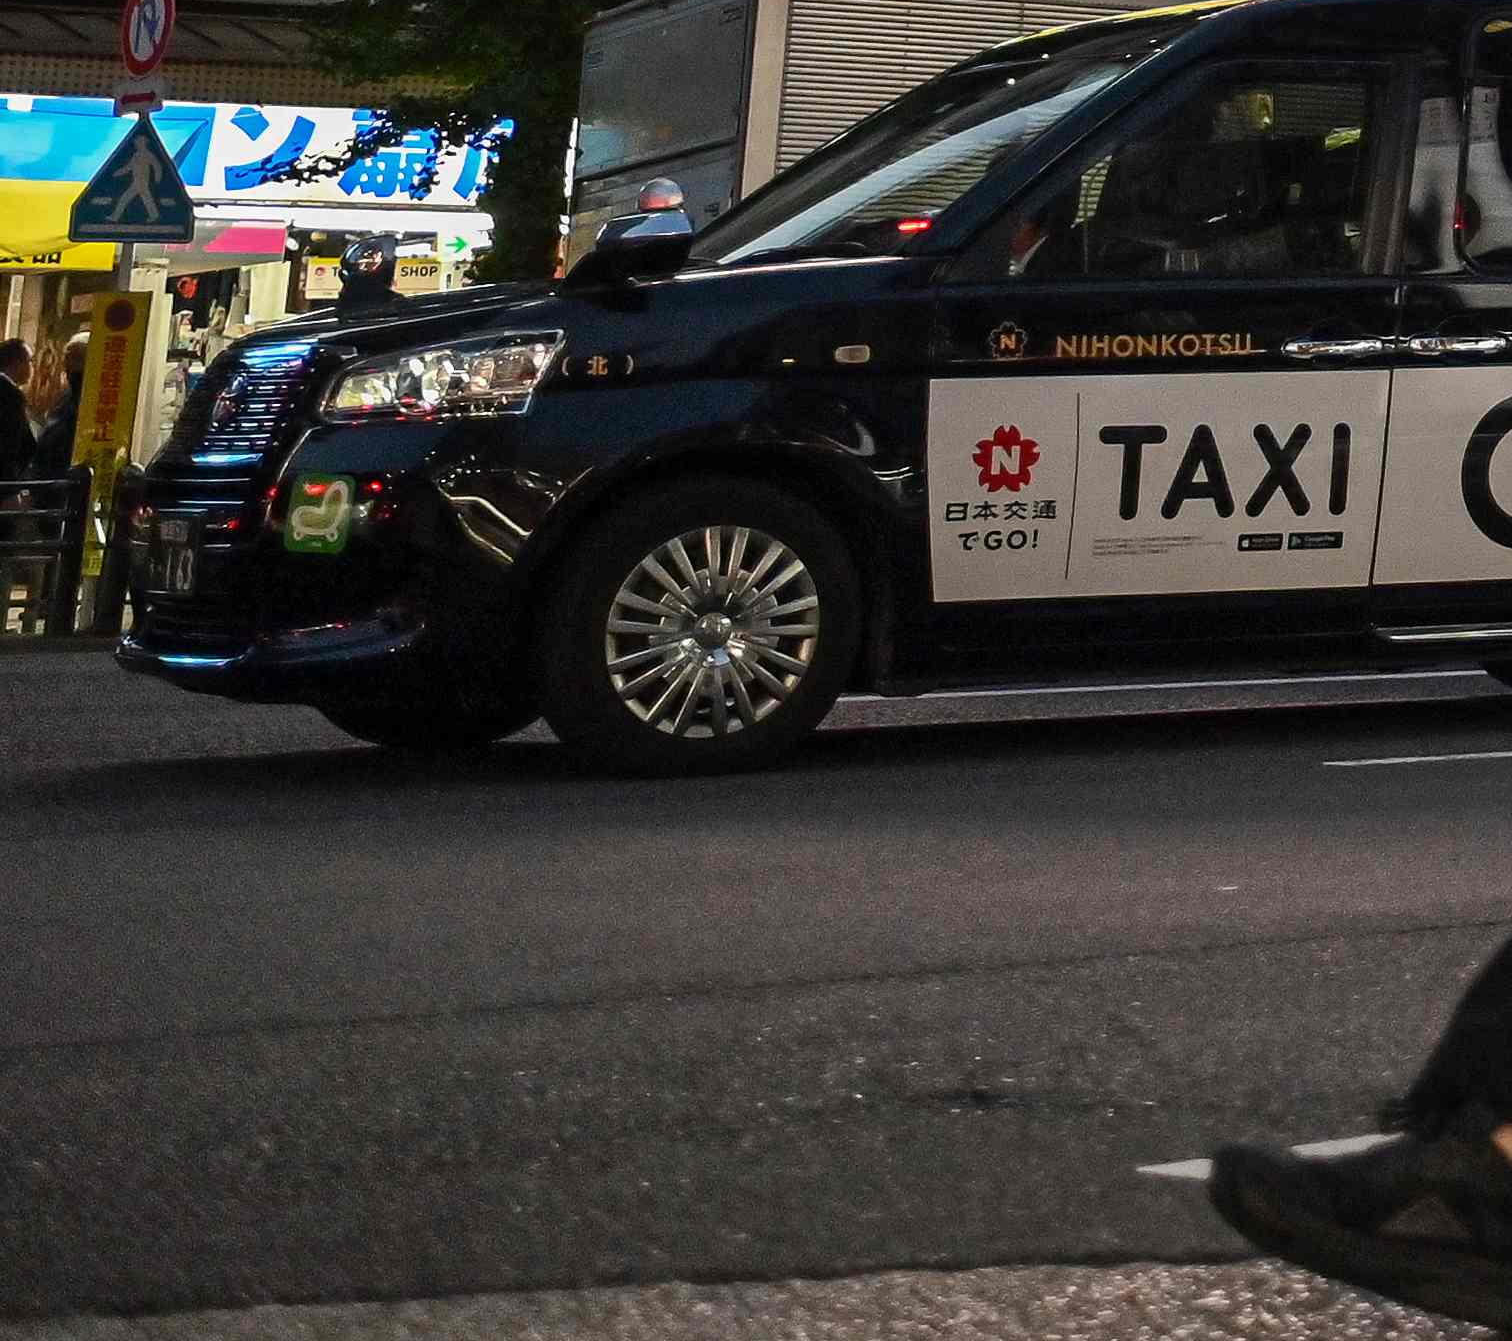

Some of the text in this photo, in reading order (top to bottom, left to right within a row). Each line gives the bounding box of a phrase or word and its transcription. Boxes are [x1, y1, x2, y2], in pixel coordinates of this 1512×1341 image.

[400, 264, 438, 278] SHOP
[1055, 332, 1252, 359] NIHONKOTSU
[1098, 422, 1352, 522] TAXI
[945, 500, 1058, 523] 日本交通
[957, 528, 1040, 552] でGO!
